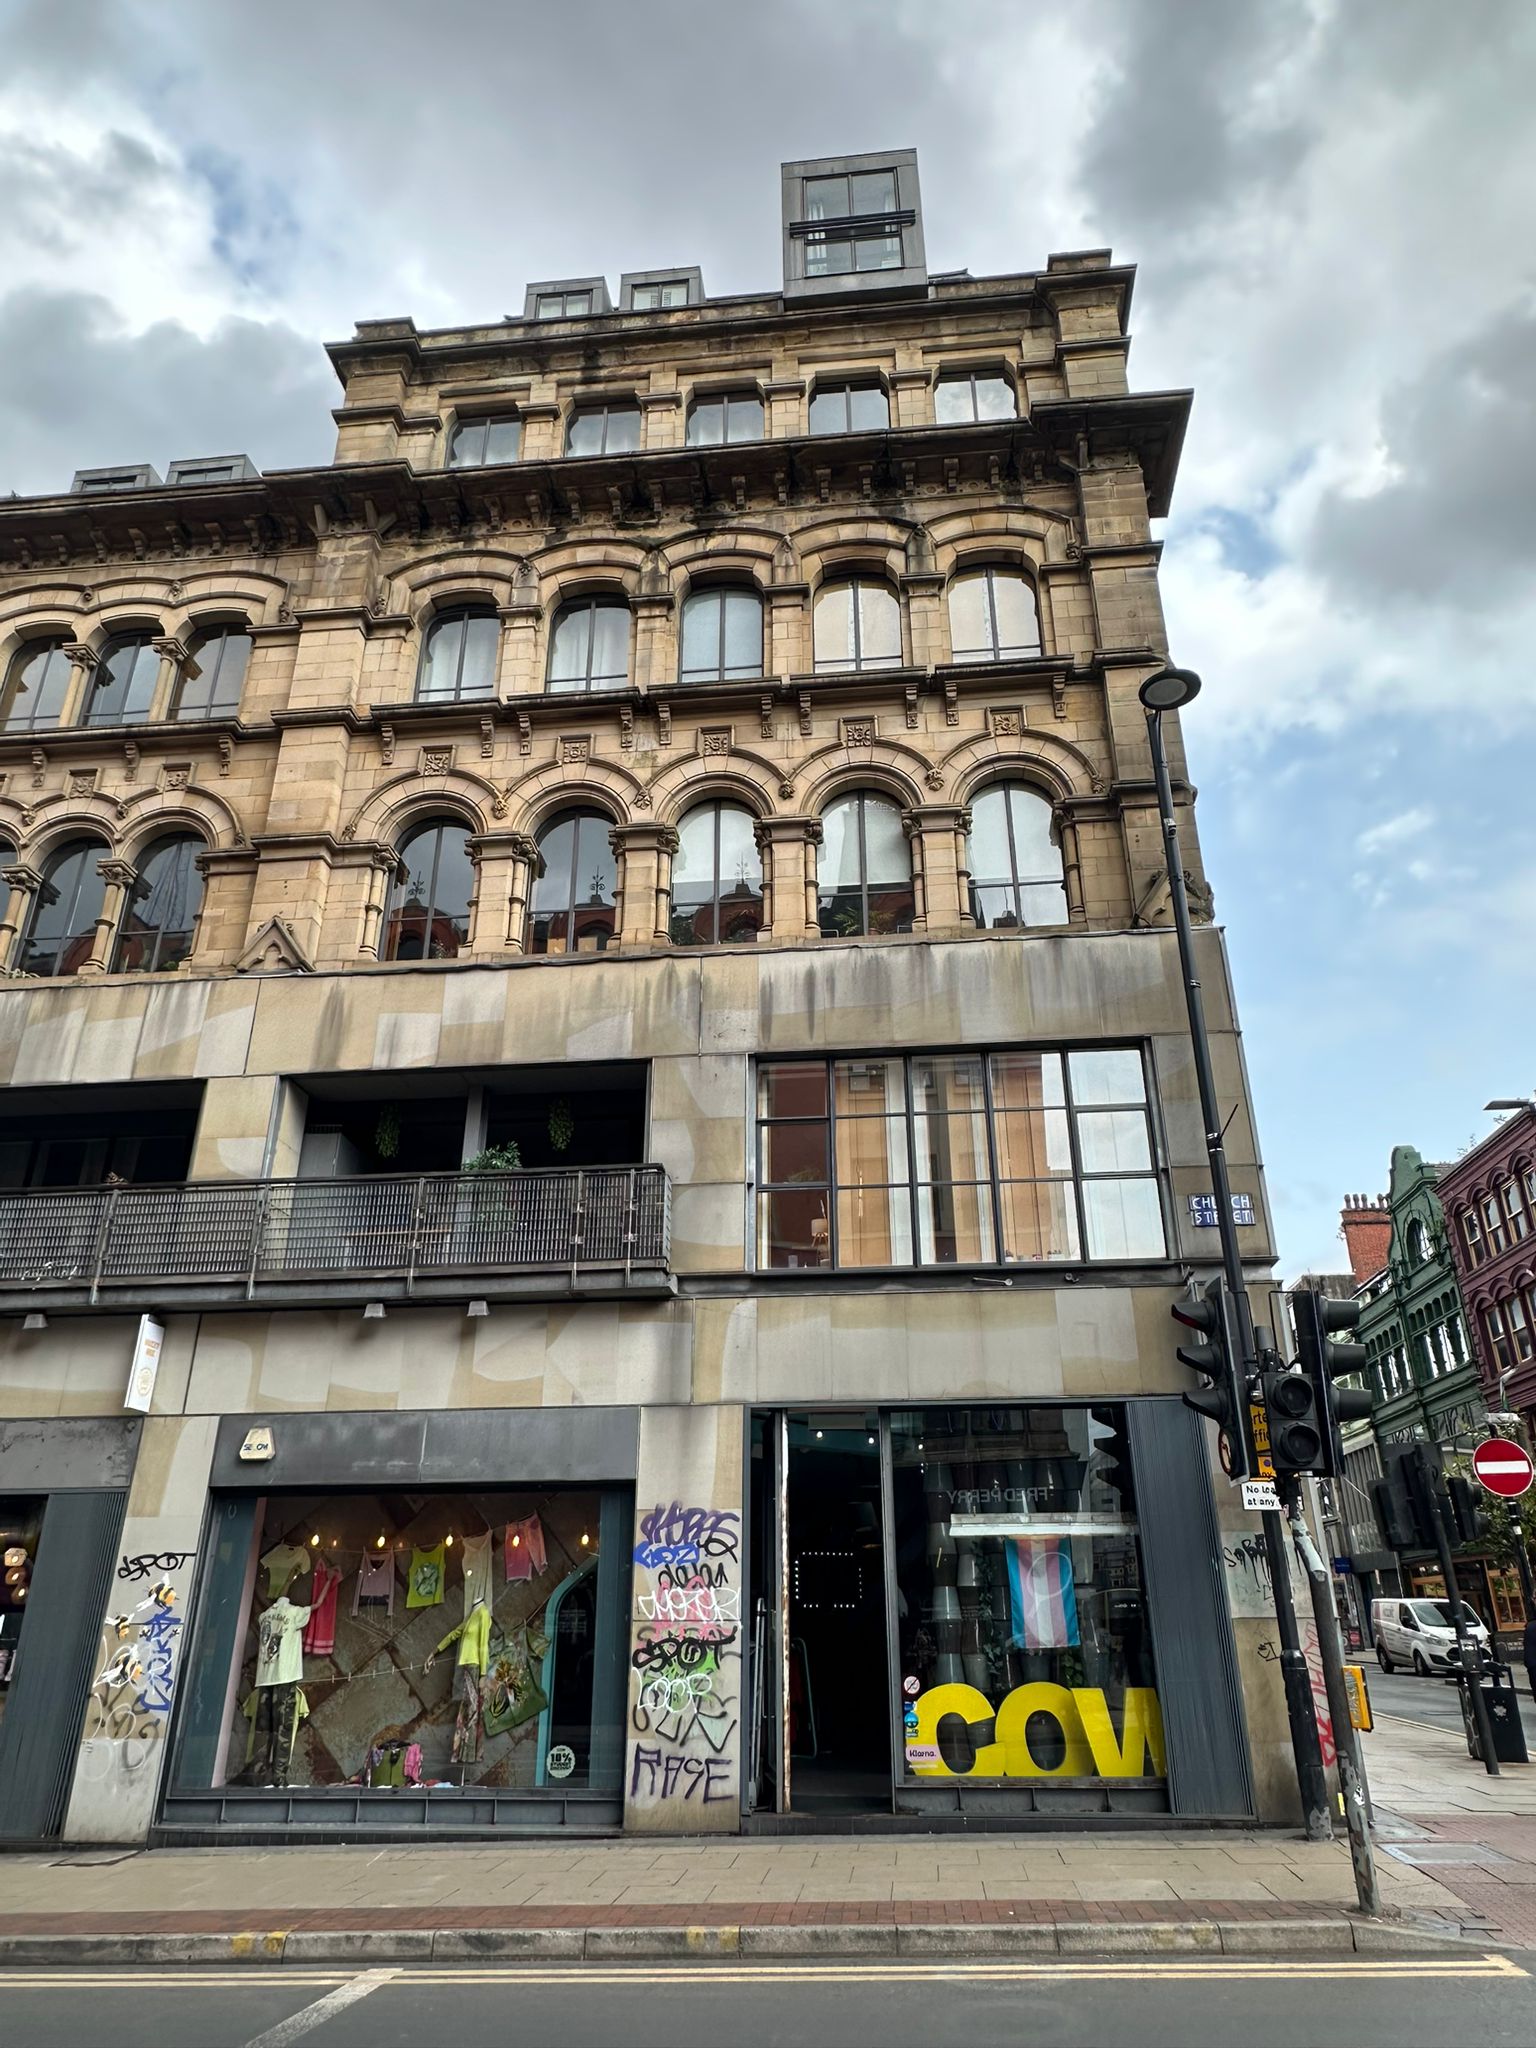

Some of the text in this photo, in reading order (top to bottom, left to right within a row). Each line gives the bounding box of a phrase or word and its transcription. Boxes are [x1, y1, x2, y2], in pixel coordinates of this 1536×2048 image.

[1193, 1195, 1250, 1209] CHUCH
[1195, 1210, 1250, 1223] STRET
[1246, 1485, 1259, 1494] No
[1247, 1497, 1276, 1507] at any
[551, 1752, 572, 1763] 10%
